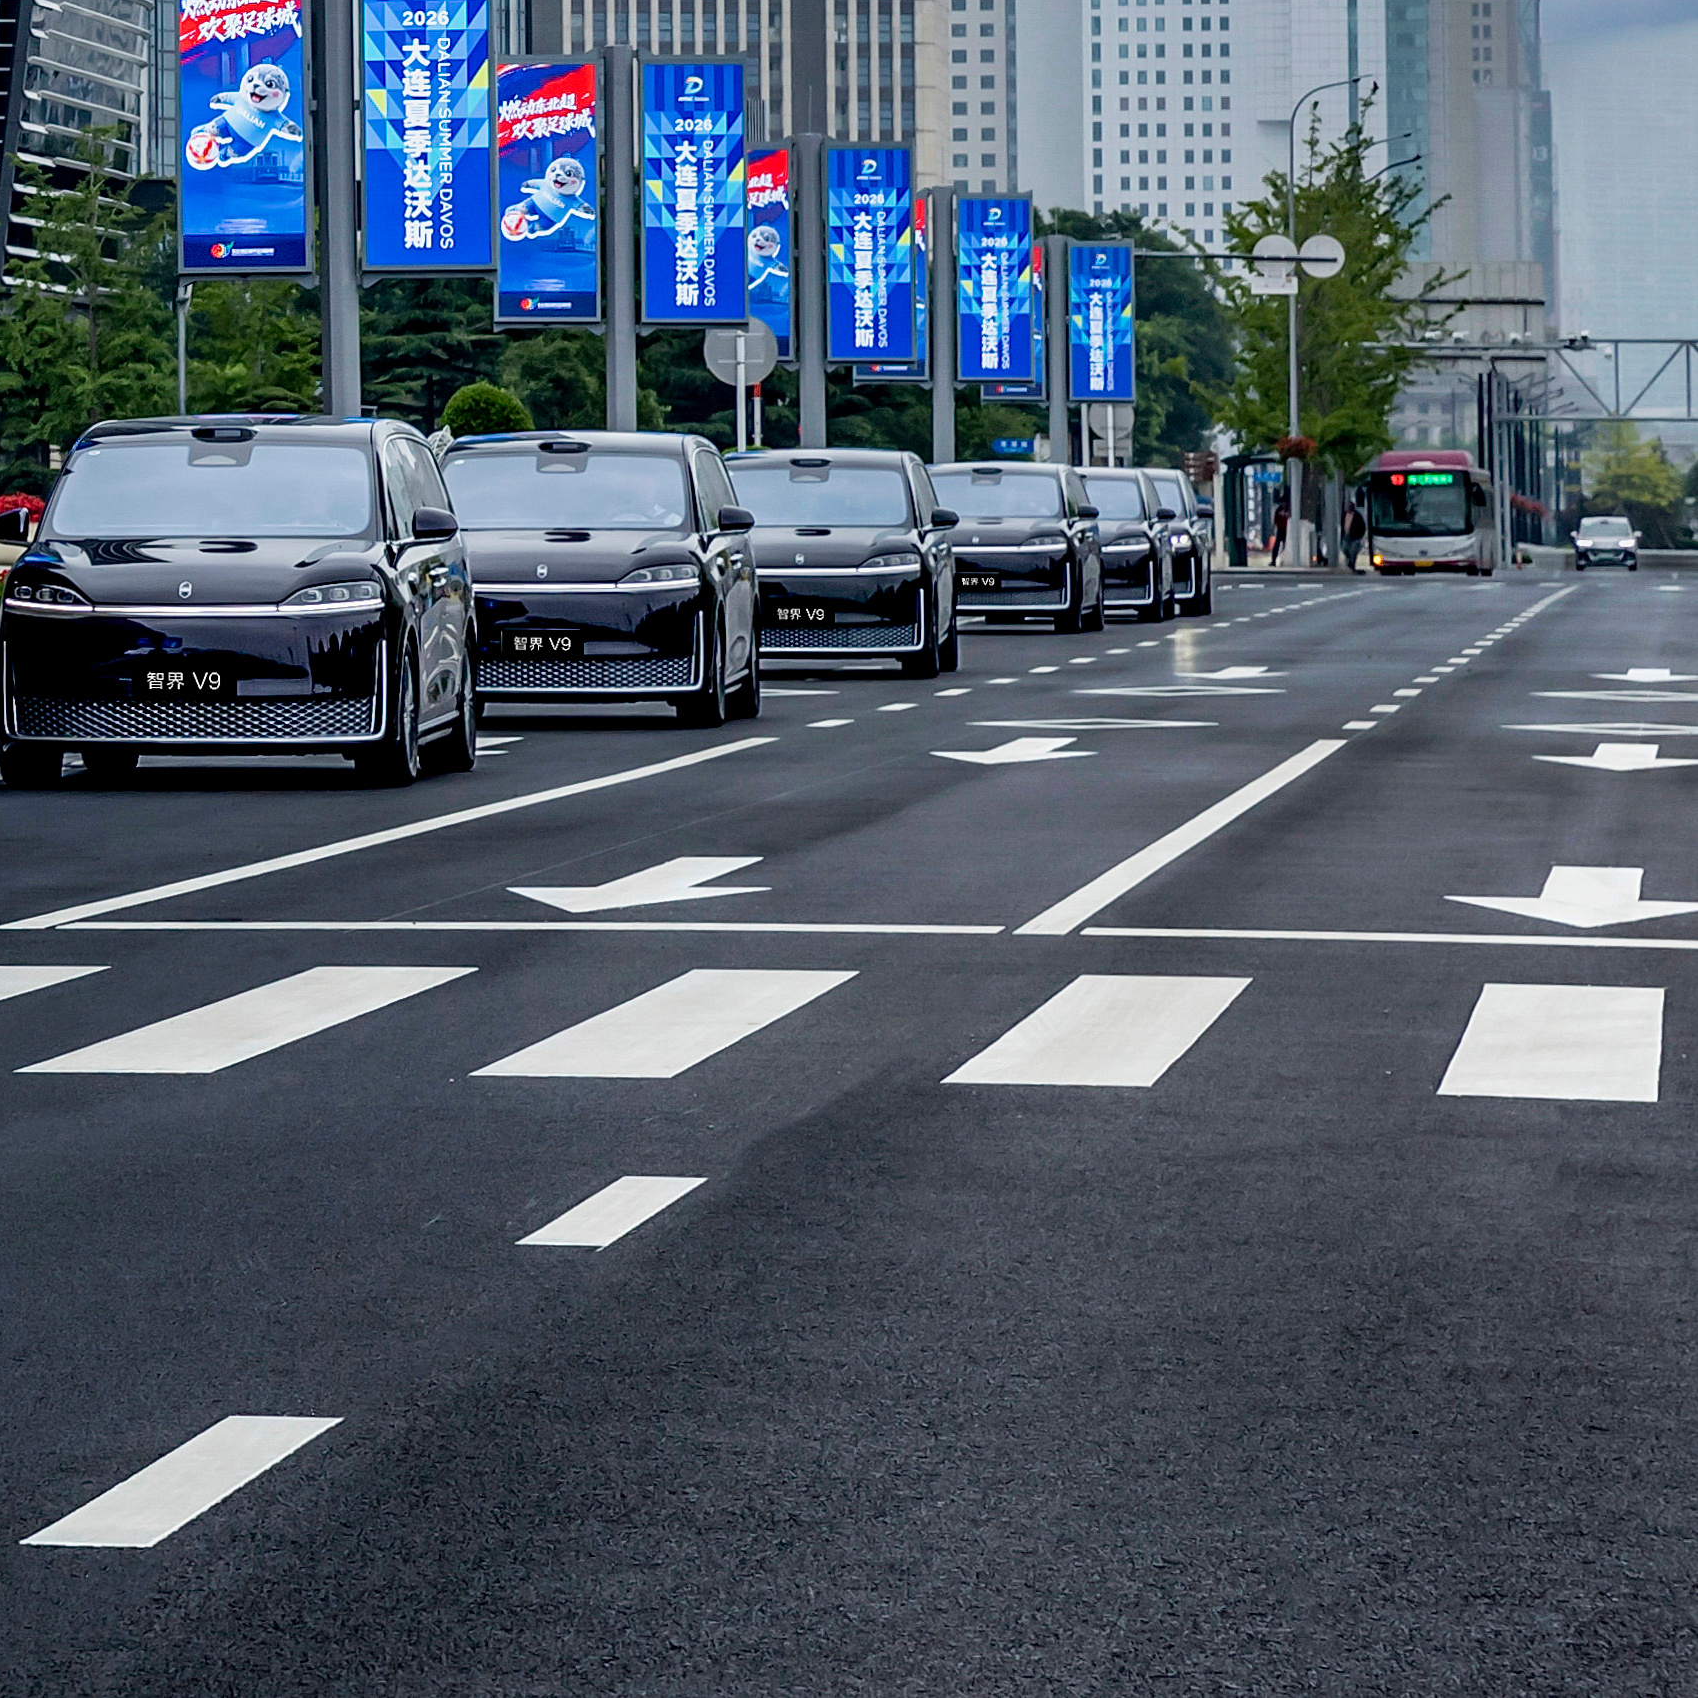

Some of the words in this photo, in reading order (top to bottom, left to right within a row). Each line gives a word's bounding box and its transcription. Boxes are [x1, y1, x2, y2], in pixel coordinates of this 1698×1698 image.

[197, 0, 302, 42] 欢聚足球城
[402, 10, 449, 26] 2026
[437, 37, 451, 103] DALIAN
[402, 38, 434, 249] 大连夏季达沃斯
[438, 107, 453, 184] SUMMER
[675, 118, 713, 132] 2026
[703, 140, 714, 192] DALIAN
[439, 188, 454, 249] DAVOS
[675, 140, 699, 306] 大连夏季达沃斯
[703, 195, 715, 255] SUMMER
[704, 259, 716, 306] DAVOS
[981, 577, 995, 586] V9
[777, 608, 802, 621] 智界
[805, 608, 825, 621] V9
[513, 636, 544, 651] 智界
[548, 636, 572, 652] V9
[146, 671, 185, 690] 智界
[192, 671, 221, 691] V9
